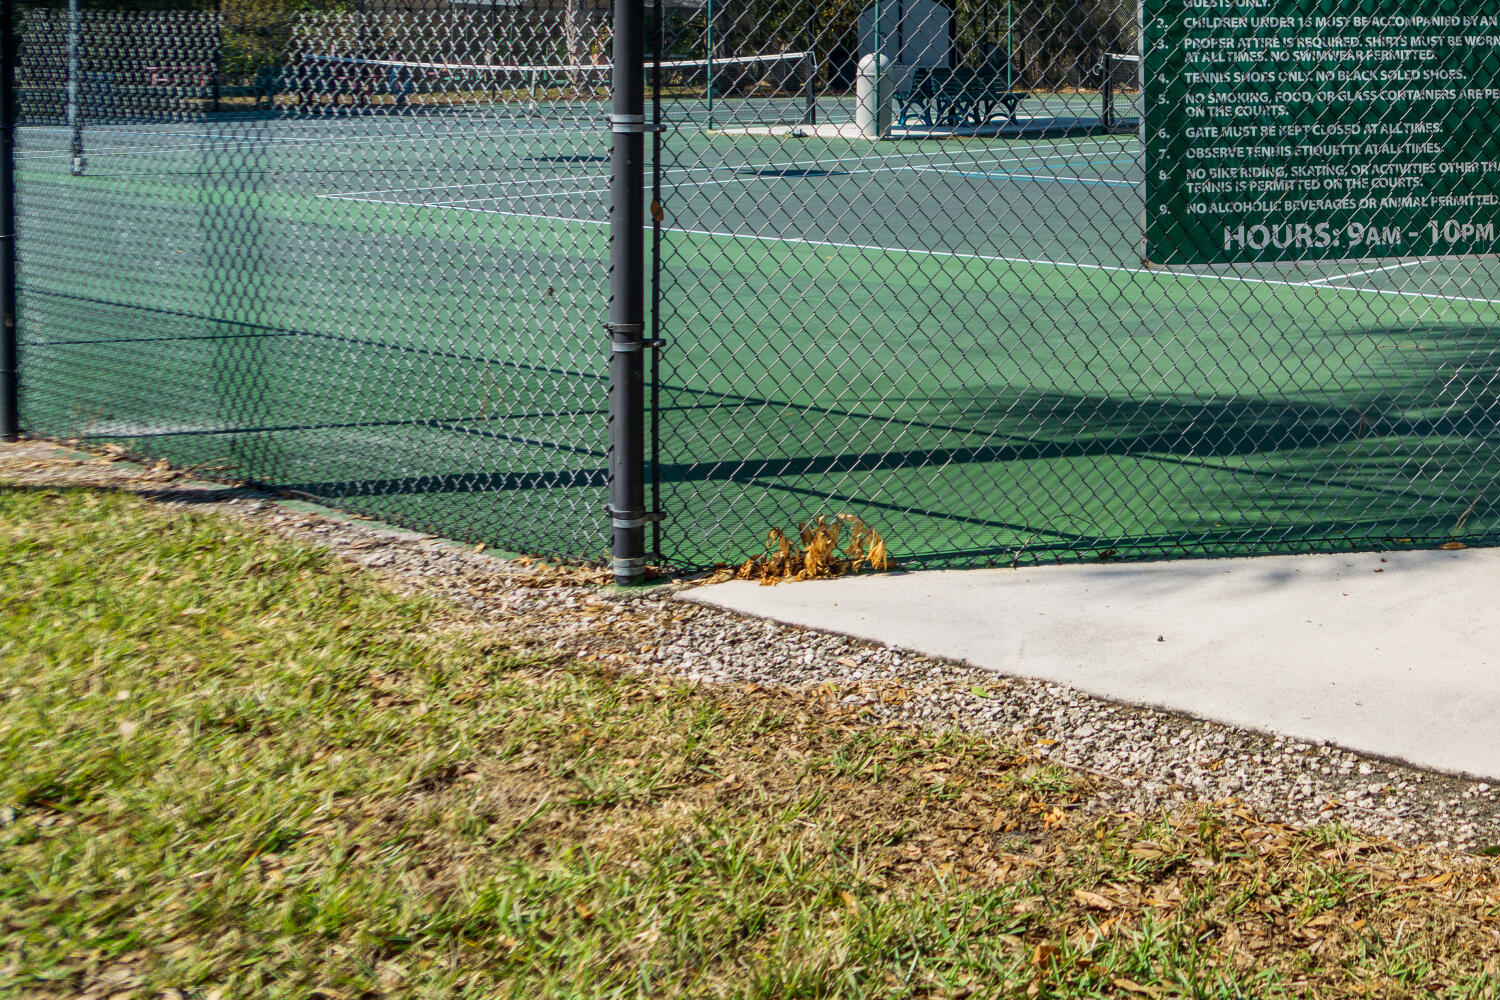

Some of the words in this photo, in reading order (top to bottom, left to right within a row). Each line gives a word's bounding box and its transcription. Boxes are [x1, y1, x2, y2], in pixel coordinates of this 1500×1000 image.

[1157, 19, 1168, 28] 2.
[1184, 17, 1248, 28] CHILDREN
[1251, 17, 1295, 27] UNDER
[1316, 17, 1350, 27] MUST
[1354, 17, 1368, 27] BE
[1372, 16, 1460, 26] ACCOMPANIED
[1463, 16, 1478, 26] BY
[1480, 16, 1497, 26] AN
[1157, 39, 1168, 49] 3.
[1184, 38, 1234, 49] PROPER
[1237, 38, 1280, 48] ATTIRE
[1283, 38, 1294, 48] IS
[1297, 37, 1361, 48] REQUIRED.
[1367, 37, 1407, 47] SHIRTS
[1410, 36, 1445, 47] MUST
[1448, 36, 1463, 46] BE
[1184, 52, 1199, 63] AT
[1204, 52, 1225, 62] ALL
[1227, 52, 1267, 62] TIMES.
[1271, 51, 1289, 62] NO
[1293, 50, 1366, 61] SWIMWEAR
[1367, 50, 1437, 60] PERMITTED.
[1158, 73, 1169, 83] 4.
[1185, 72, 1230, 83] TENNIS
[1234, 72, 1275, 82] SHOES
[1316, 71, 1335, 81] NO
[1338, 70, 1377, 81] BLACK
[1381, 70, 1420, 80] SOLED
[1423, 69, 1466, 79] SHOES.
[1159, 94, 1169, 104] 5.
[1185, 93, 1204, 104] NO
[1208, 92, 1272, 105] SMOKING,
[1276, 92, 1313, 103] FOOD,
[1317, 92, 1335, 102] OR
[1338, 90, 1376, 101] GLASS
[1380, 89, 1456, 100] CONTAINERS
[1459, 89, 1482, 99] ARE
[1185, 106, 1204, 117] ON
[1209, 106, 1232, 116] THE
[1235, 105, 1289, 116] COURTS.
[1159, 128, 1170, 138] 6.
[1186, 127, 1218, 138] GATE
[1222, 126, 1257, 137] MUST
[1261, 126, 1276, 136] BE
[1279, 125, 1311, 136] KEPT
[1312, 124, 1360, 135] CLOSED
[1364, 124, 1379, 134] AT
[1381, 124, 1404, 134] ALL
[1404, 123, 1443, 133] TIMES.
[1159, 149, 1170, 159] 7.
[1186, 147, 1243, 158] OBSERVE
[1246, 146, 1291, 157] TENNIS
[1295, 145, 1360, 156] ETIQUETTE
[1364, 144, 1379, 154] AT
[1382, 144, 1401, 154] ALL
[1159, 170, 1170, 180] 8.
[1187, 168, 1206, 179] NO
[1209, 168, 1236, 178] BIKE
[1240, 167, 1287, 179] RIDING,
[1291, 165, 1348, 177] SKATING,
[1351, 165, 1369, 175] OR
[1372, 163, 1436, 174] ACTIVITIES
[1439, 162, 1479, 173] OTHER
[1187, 182, 1232, 193] TENNIS
[1236, 181, 1246, 192] IS
[1249, 180, 1320, 191] PERMITTED
[1323, 179, 1343, 189] ON
[1345, 178, 1368, 189] THE
[1371, 177, 1423, 188] COURTS.
[1187, 203, 1206, 214] NO
[1209, 201, 1281, 214] ALCOHOLIC
[1285, 199, 1356, 211] BEVERAGES
[1359, 198, 1377, 209] OR
[1379, 197, 1428, 208] ANIMAL
[1224, 223, 1340, 250] HOURS:
[1348, 223, 1401, 245] 9AM
[1427, 220, 1494, 244] 10PM
